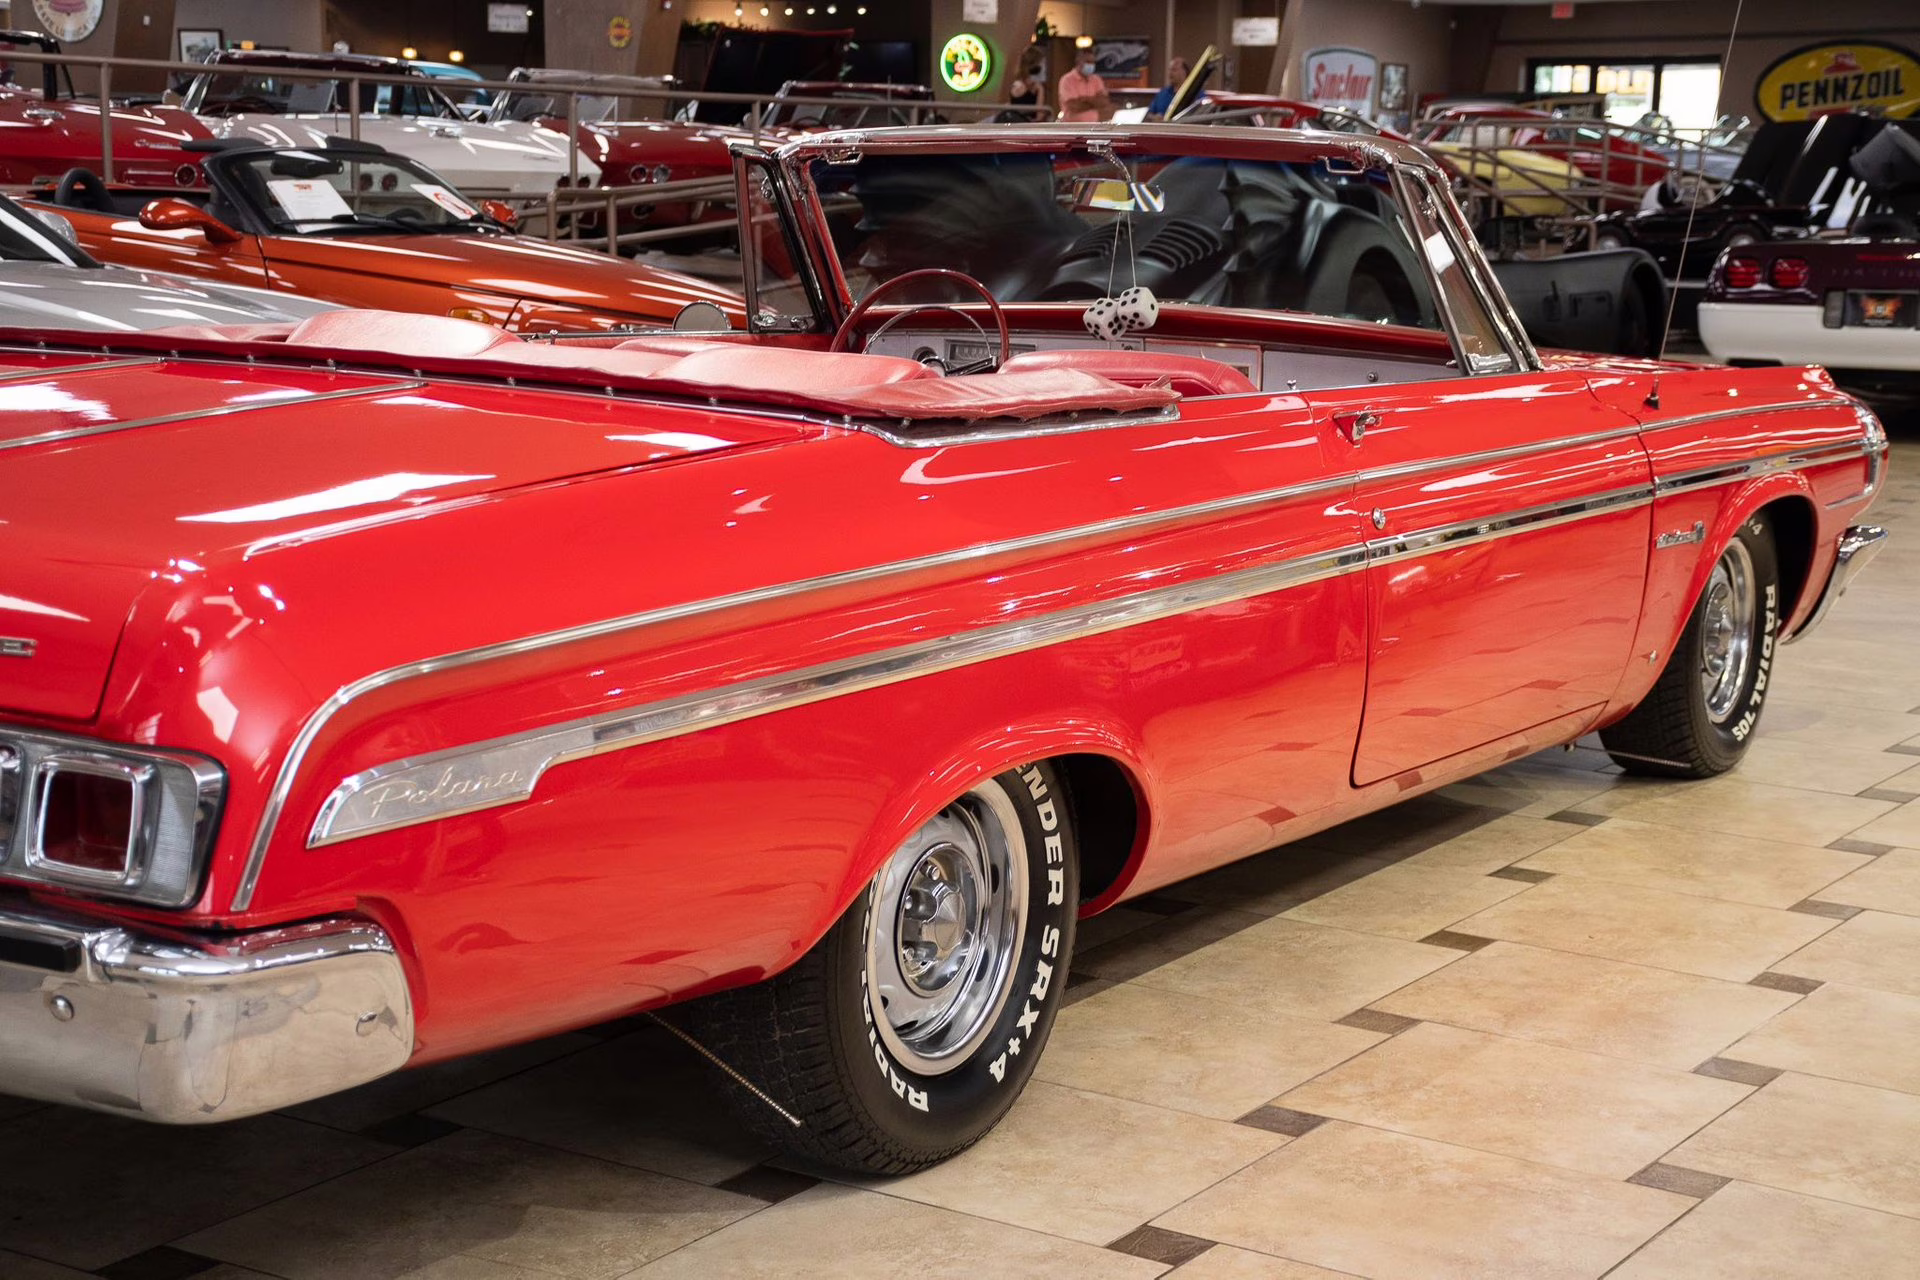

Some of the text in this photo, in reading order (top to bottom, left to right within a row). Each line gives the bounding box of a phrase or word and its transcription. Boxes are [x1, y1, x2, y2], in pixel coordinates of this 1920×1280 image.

[1779, 67, 1905, 111] PENNZOIL
[1731, 583, 1778, 743] RADIAL 70S
[363, 765, 523, 819] Polara
[988, 924, 1061, 1084] SRX+4
